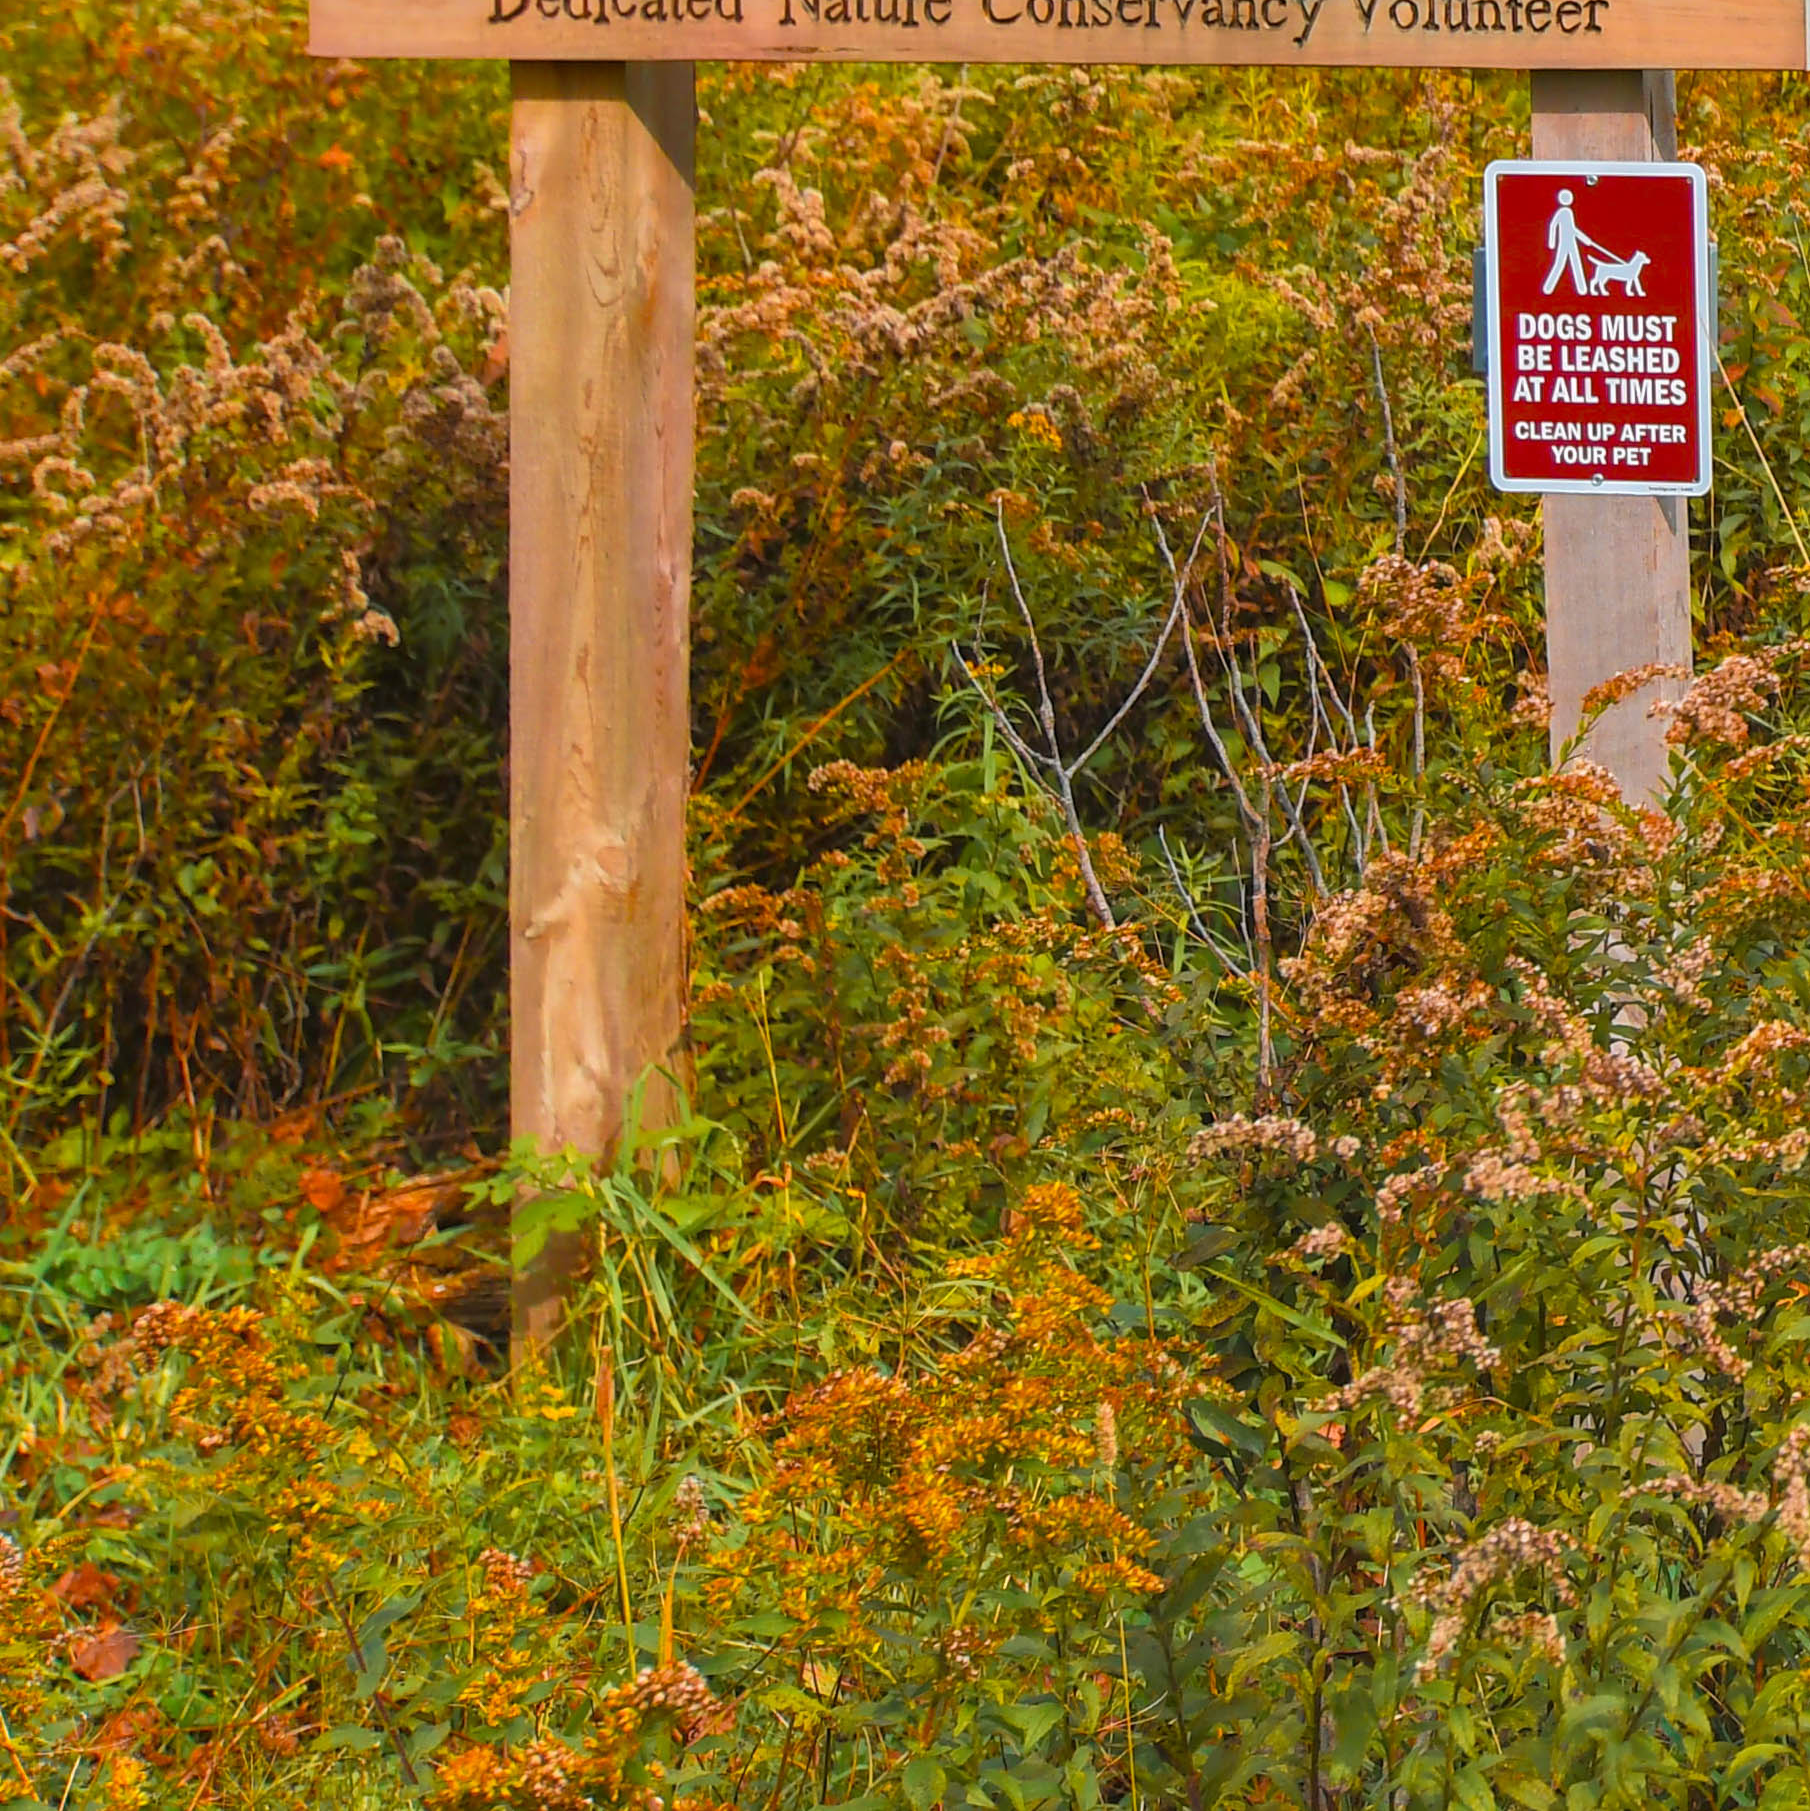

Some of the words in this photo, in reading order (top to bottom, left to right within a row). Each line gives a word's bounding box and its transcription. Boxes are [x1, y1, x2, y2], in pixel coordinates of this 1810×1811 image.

[1518, 313, 1592, 340] DOGS
[1601, 315, 1677, 342] MUST
[1518, 345, 1552, 371] BE
[1562, 346, 1680, 374] LEASHED
[1513, 376, 1545, 402] AT
[1551, 377, 1599, 404] ALL
[1605, 378, 1687, 405] TIMES
[1515, 421, 1581, 441] CLEAN
[1587, 423, 1615, 442] UP
[1620, 423, 1686, 443] AFTER
[1551, 445, 1606, 464] YOUR
[1613, 446, 1651, 466] PET
